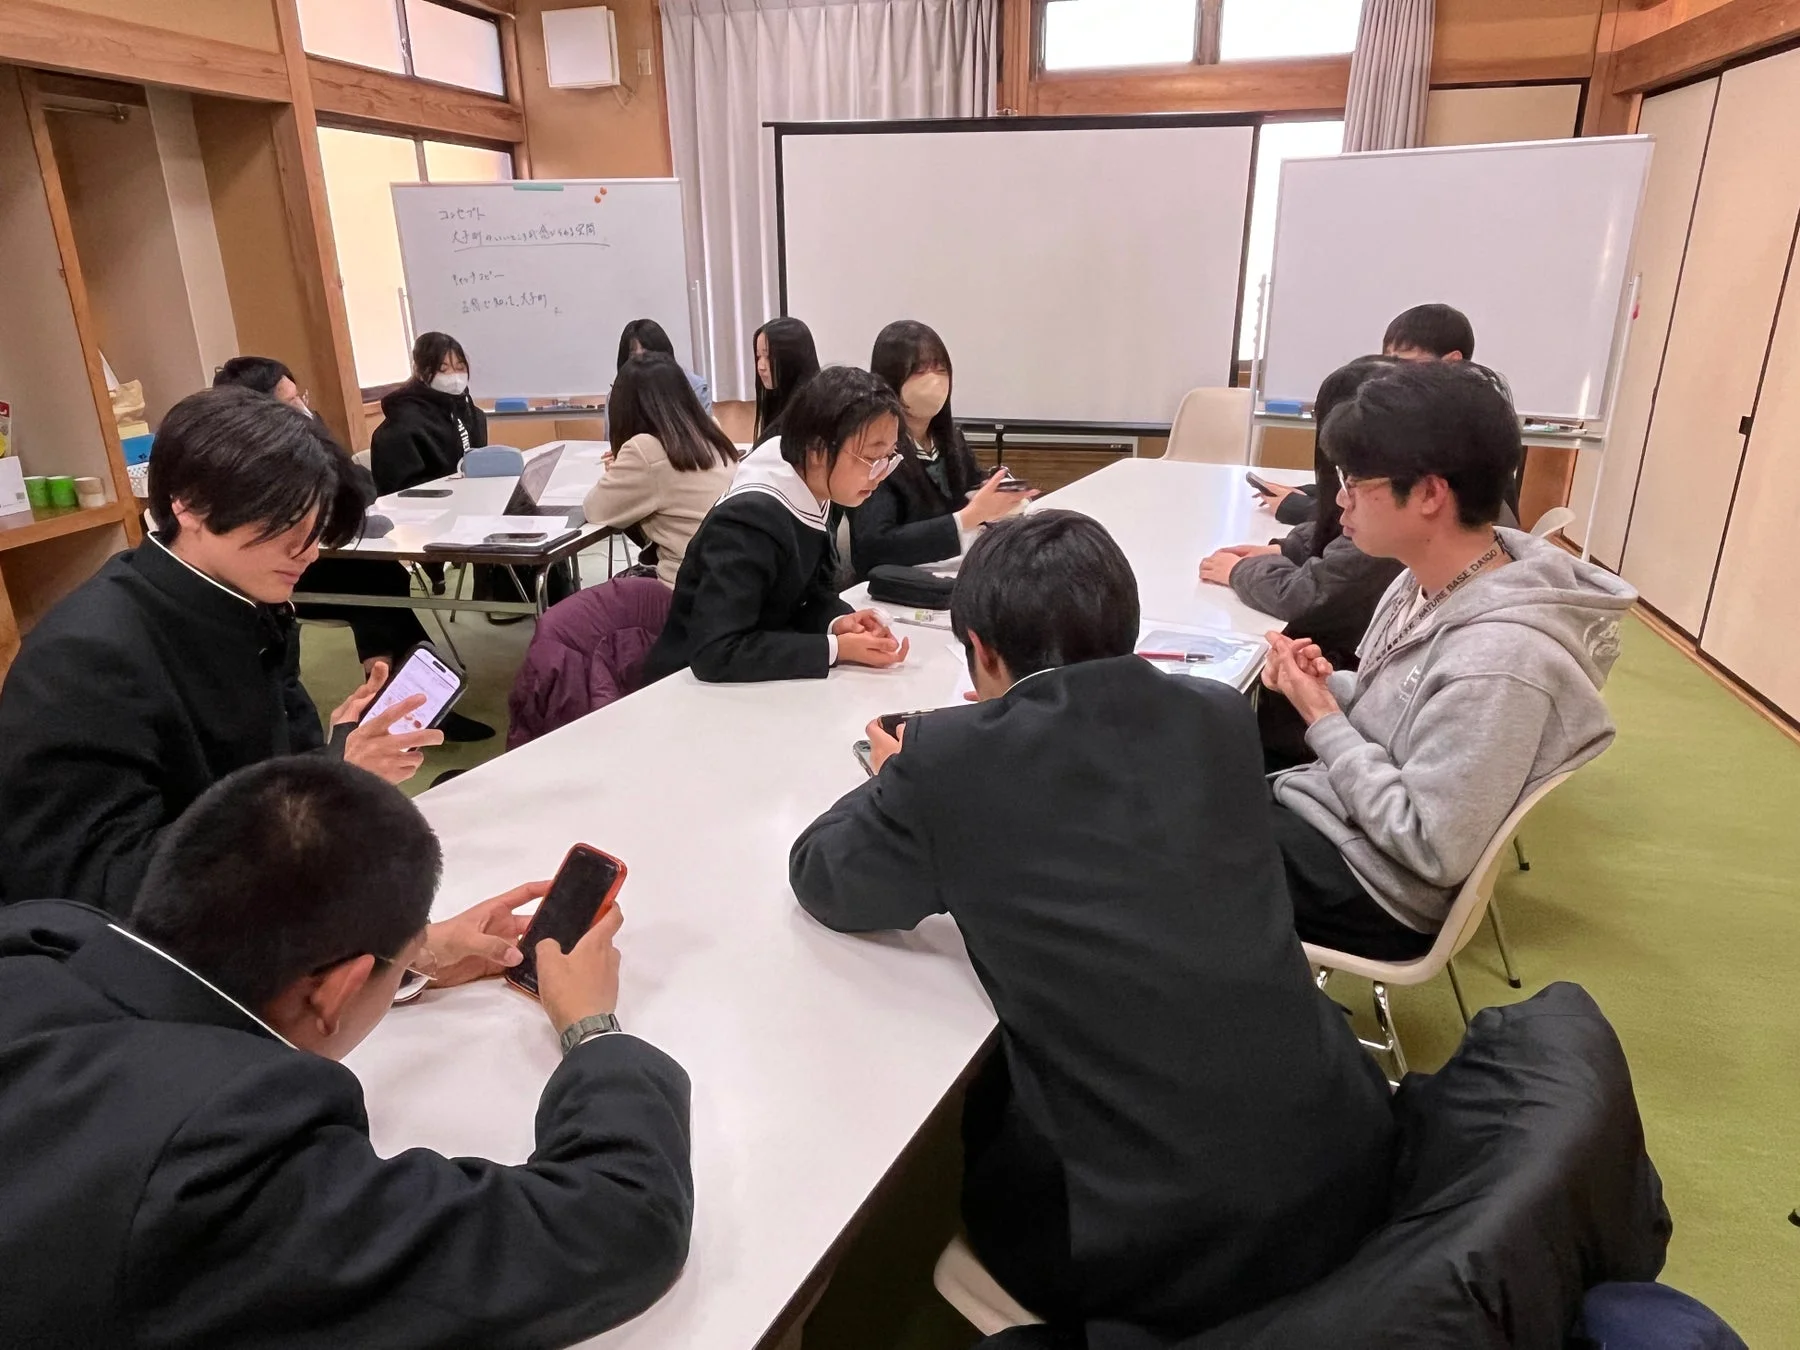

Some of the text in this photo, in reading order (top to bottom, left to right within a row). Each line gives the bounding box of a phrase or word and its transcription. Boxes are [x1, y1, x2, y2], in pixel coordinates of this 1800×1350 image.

[438, 206, 486, 221] コンセプト
[1418, 589, 1448, 620] NATURE
[1446, 569, 1471, 593] BASE
